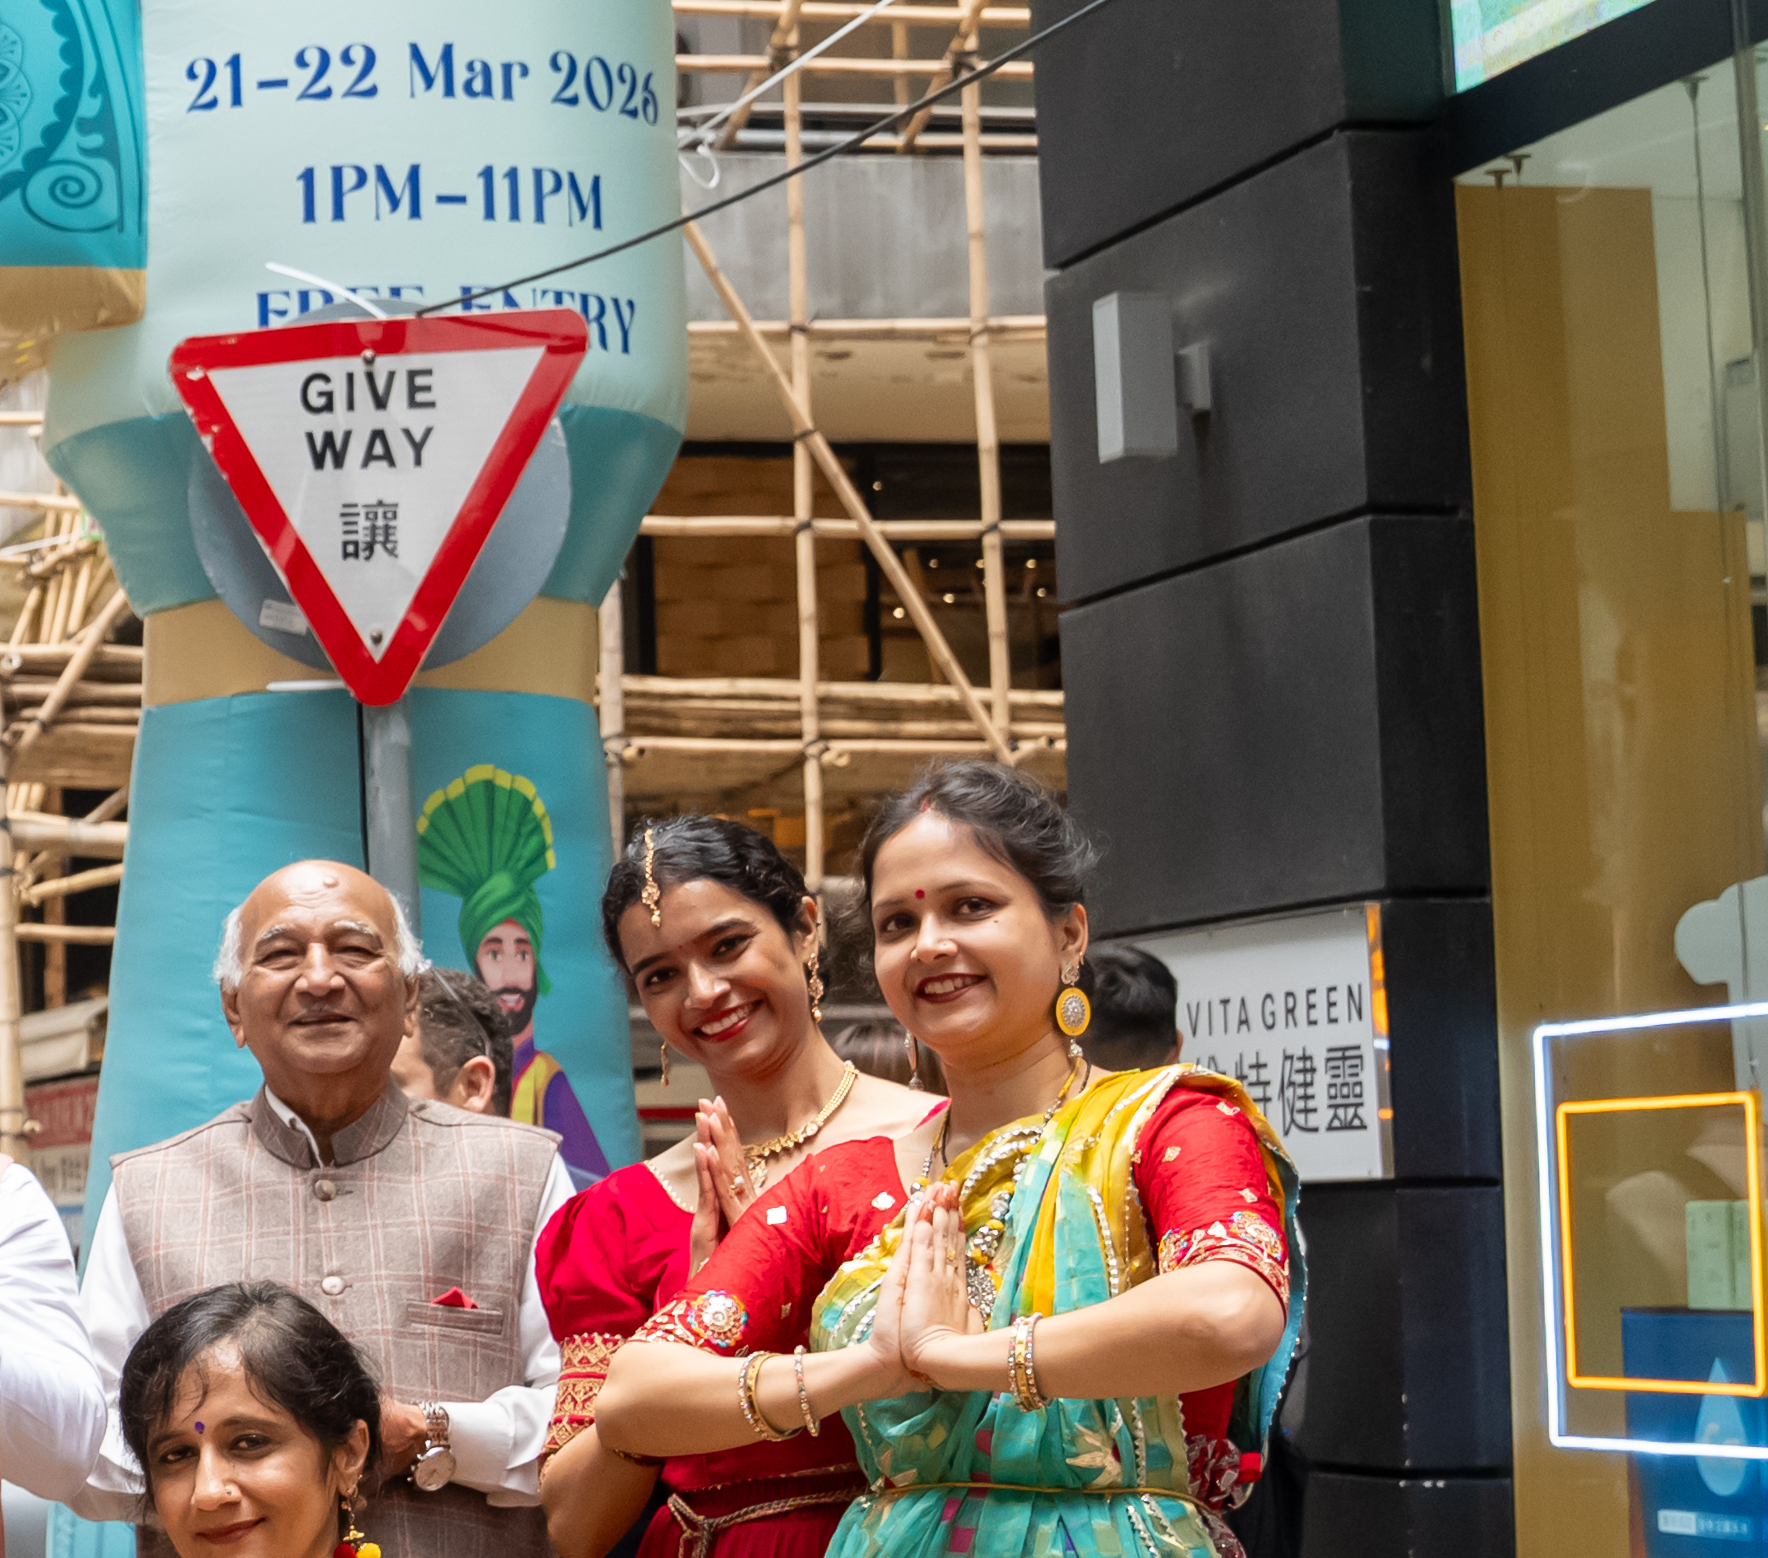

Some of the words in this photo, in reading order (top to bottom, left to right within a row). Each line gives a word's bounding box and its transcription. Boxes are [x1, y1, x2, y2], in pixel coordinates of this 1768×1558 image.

[408, 42, 530, 103] Mar
[549, 50, 659, 126] 2026
[300, 368, 437, 415] GIVE
[305, 426, 434, 471] WAY
[339, 499, 399, 562] 讓
[1196, 1045, 1368, 1137] 特健靈
